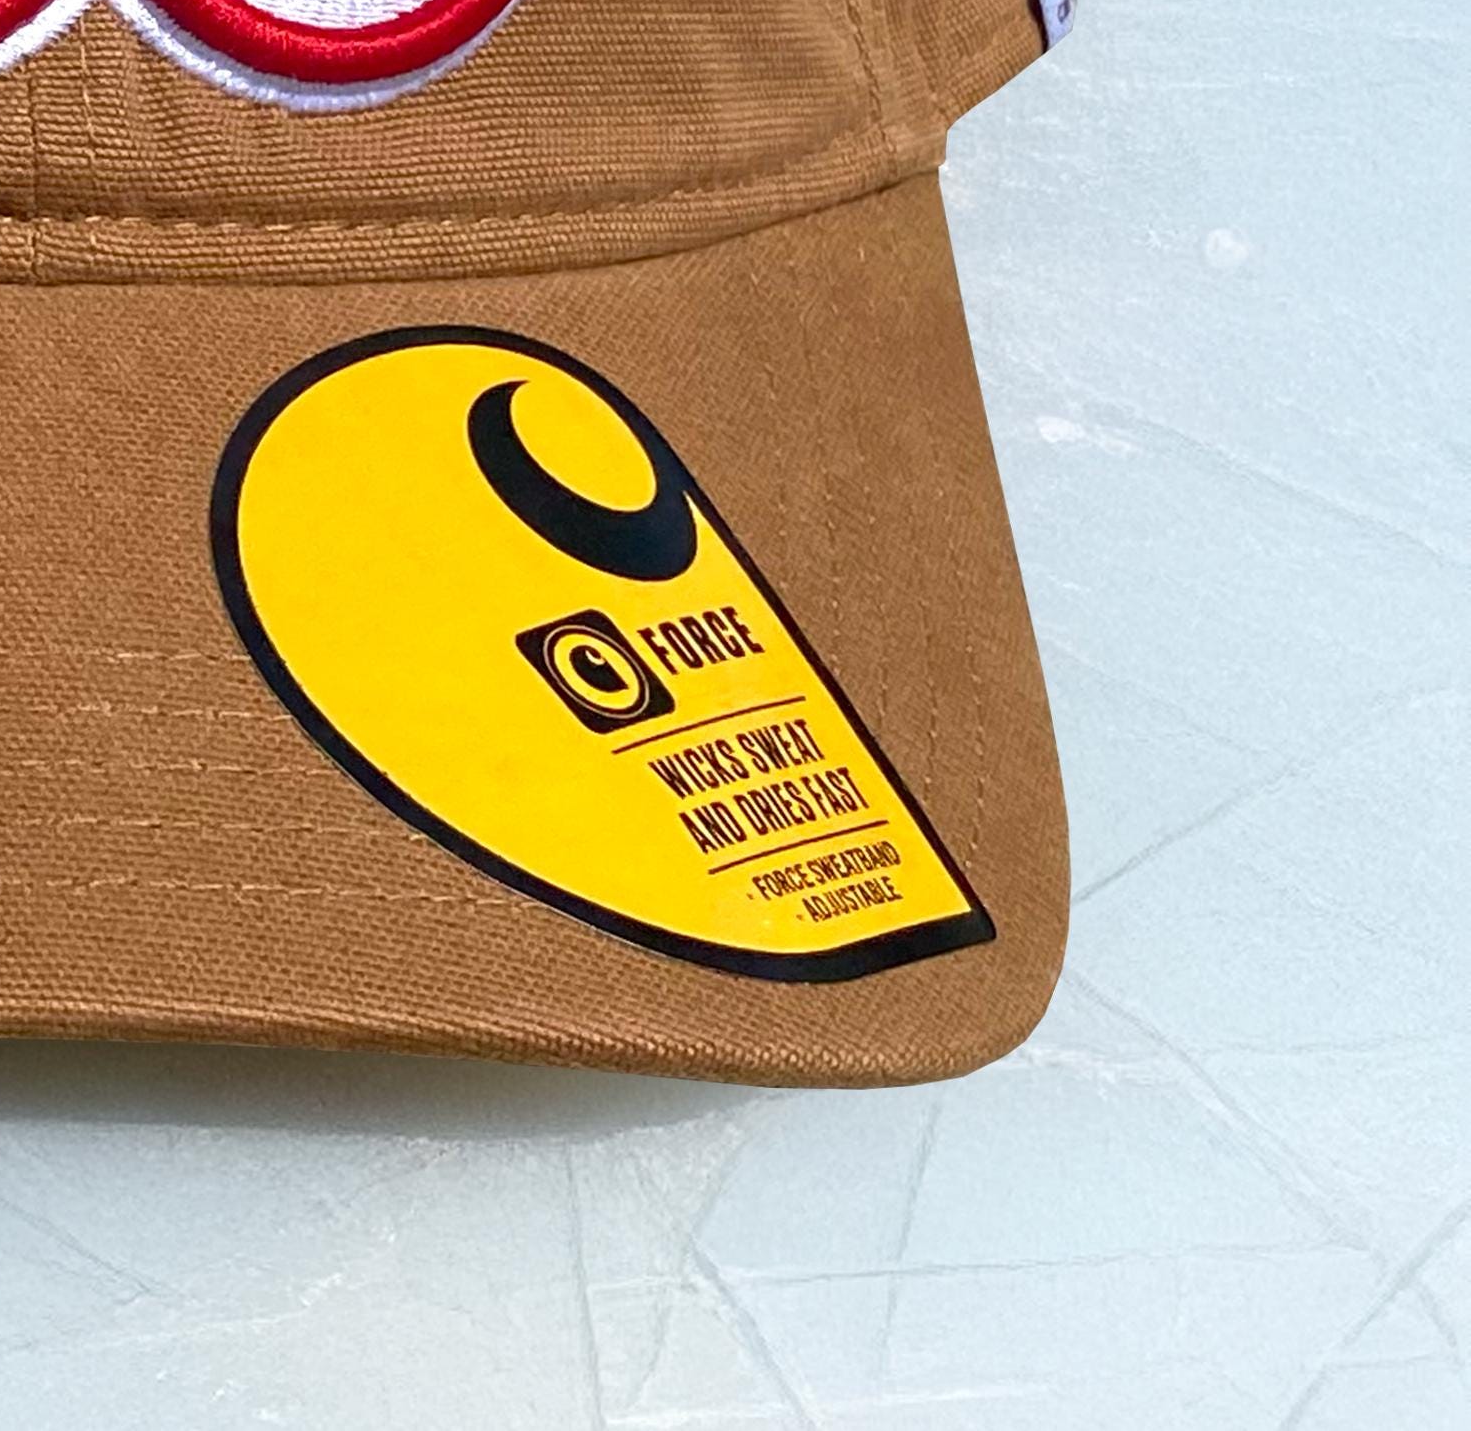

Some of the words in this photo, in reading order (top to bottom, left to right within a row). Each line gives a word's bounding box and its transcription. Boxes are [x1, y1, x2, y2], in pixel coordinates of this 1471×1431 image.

[637, 606, 765, 675] FORCE
[647, 739, 750, 799] WICKS
[736, 719, 825, 774] SWEAT
[679, 801, 748, 854] AND
[733, 781, 817, 835] DRIES
[800, 767, 869, 819] FAST
[752, 863, 815, 901] FORCE
[806, 840, 902, 885] SWEATBAND
[802, 876, 903, 922] ADJUSTABLE
